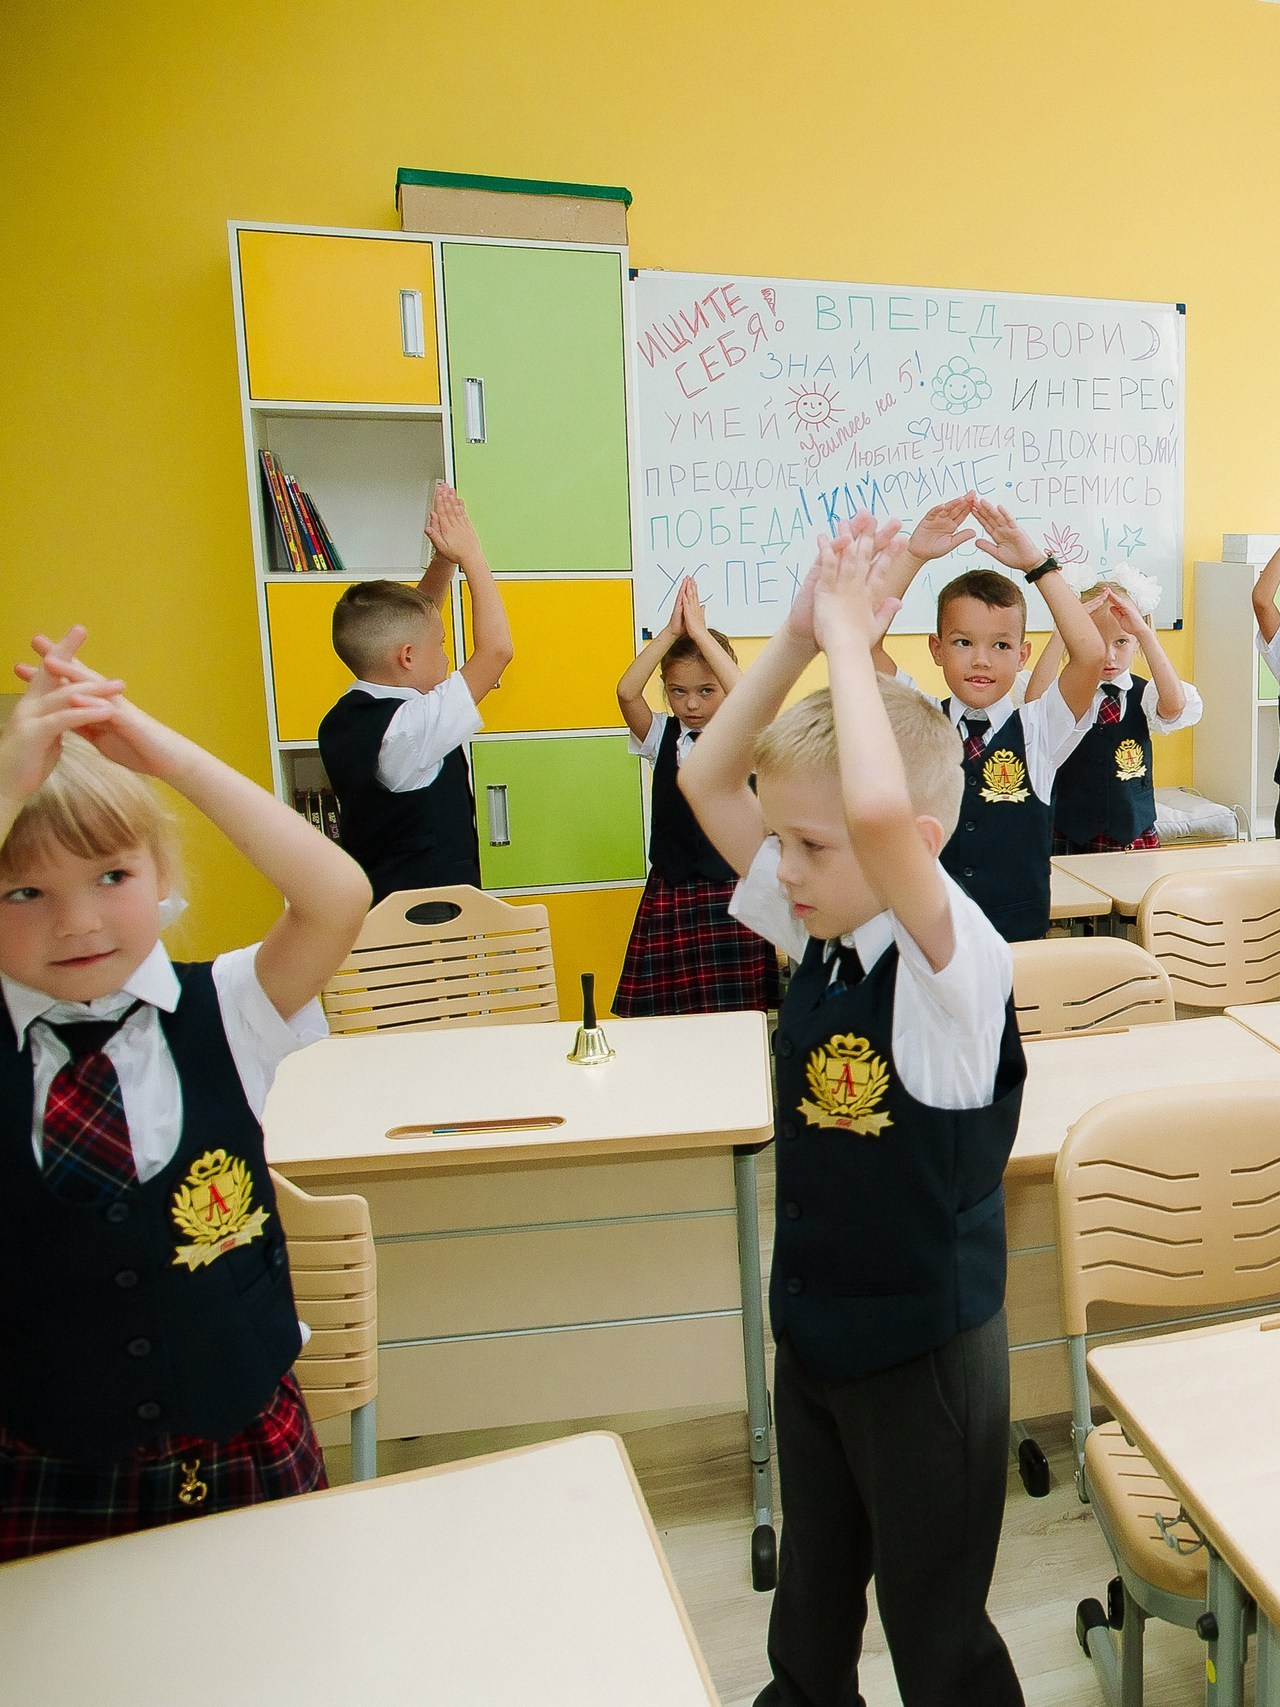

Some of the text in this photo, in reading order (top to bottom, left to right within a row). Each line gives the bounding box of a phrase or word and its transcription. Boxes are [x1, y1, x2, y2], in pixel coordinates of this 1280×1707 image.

[636, 282, 750, 369] ИЩИТЕ
[815, 295, 1003, 354] ВПЕРЕД
[1003, 320, 1126, 361] ТВОРИ
[759, 340, 873, 385] ЗНАЙ
[875, 391, 897, 417] на
[1011, 375, 1175, 412] ИНТЕРЕС
[663, 395, 781, 444] УМЕЙ
[930, 421, 1017, 454] УЧИТЕЛЯ
[1014, 474, 1162, 508] СТРЕМИСЬ
[649, 505, 806, 556] ПОБЕДА
[656, 559, 802, 613] УСПЕХ
